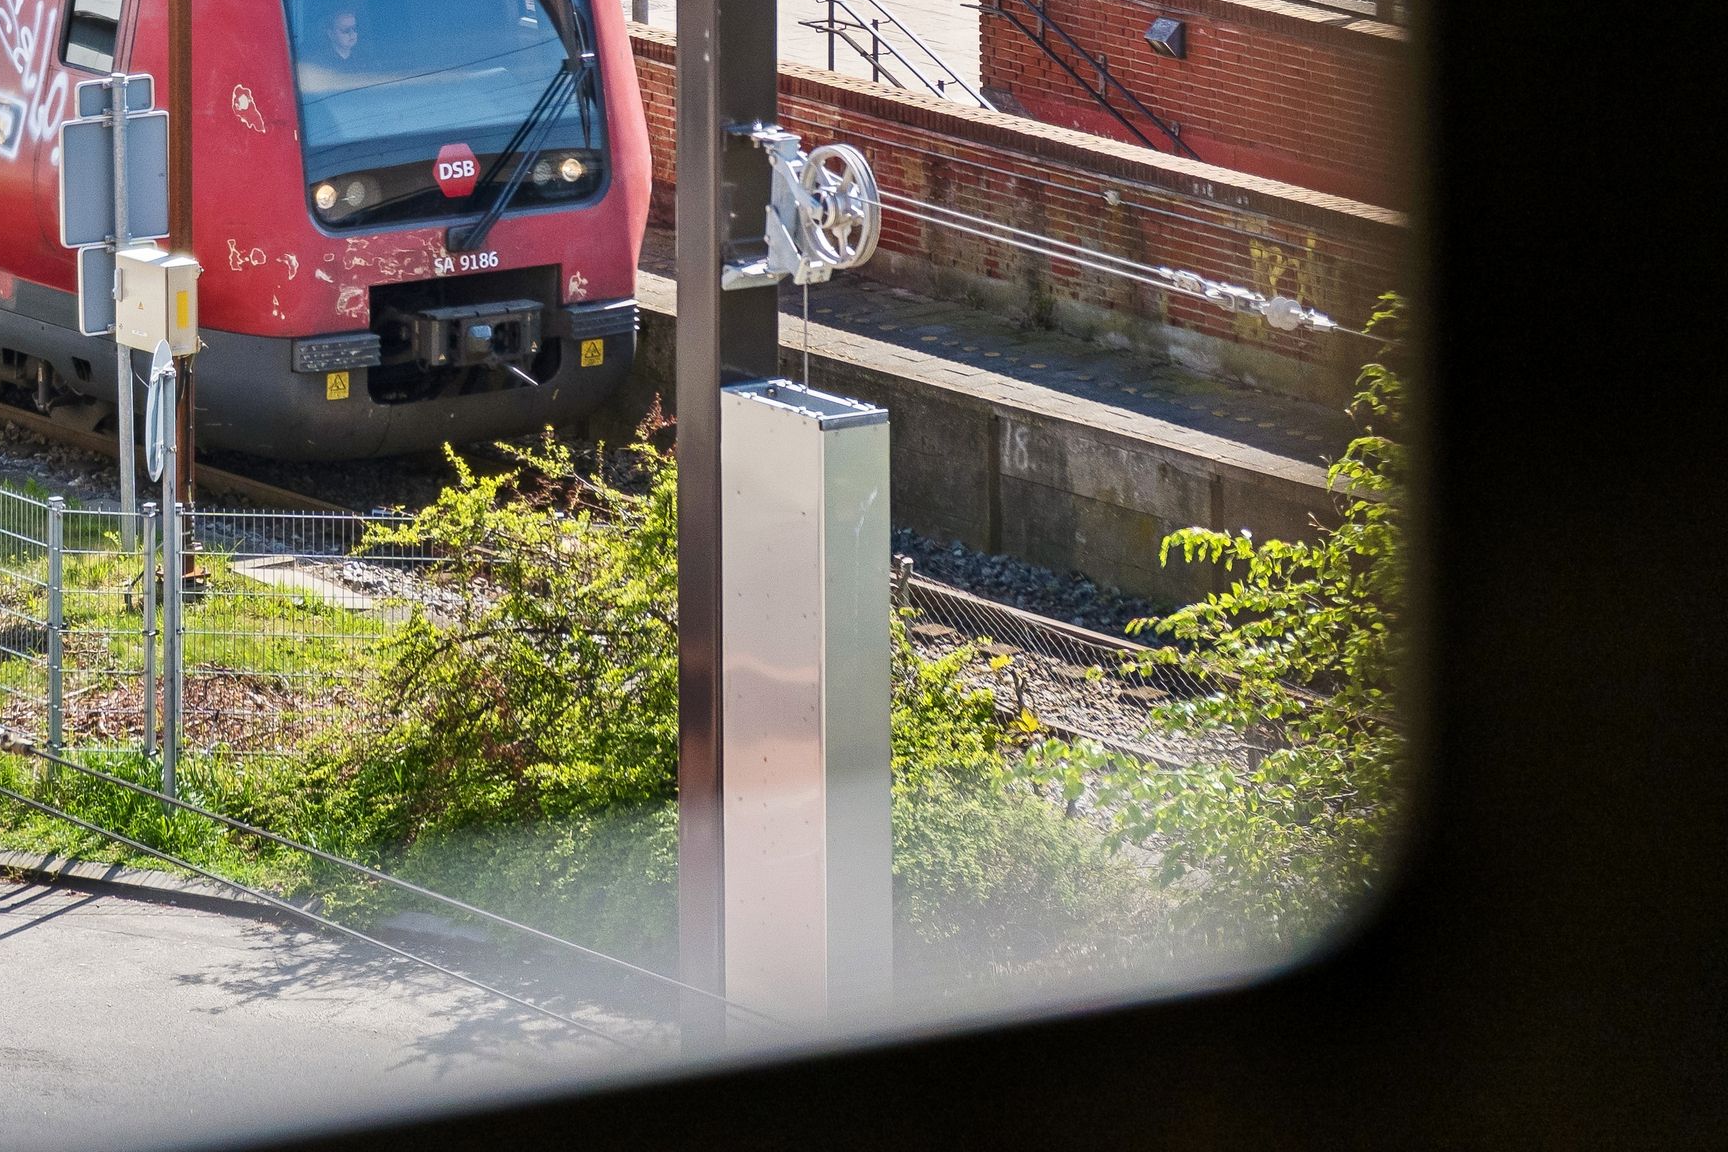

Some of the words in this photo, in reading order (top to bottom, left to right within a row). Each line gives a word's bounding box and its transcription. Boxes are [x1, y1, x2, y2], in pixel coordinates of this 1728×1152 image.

[438, 160, 475, 180] DSB
[434, 256, 455, 273] SA
[460, 251, 499, 271] 9186
